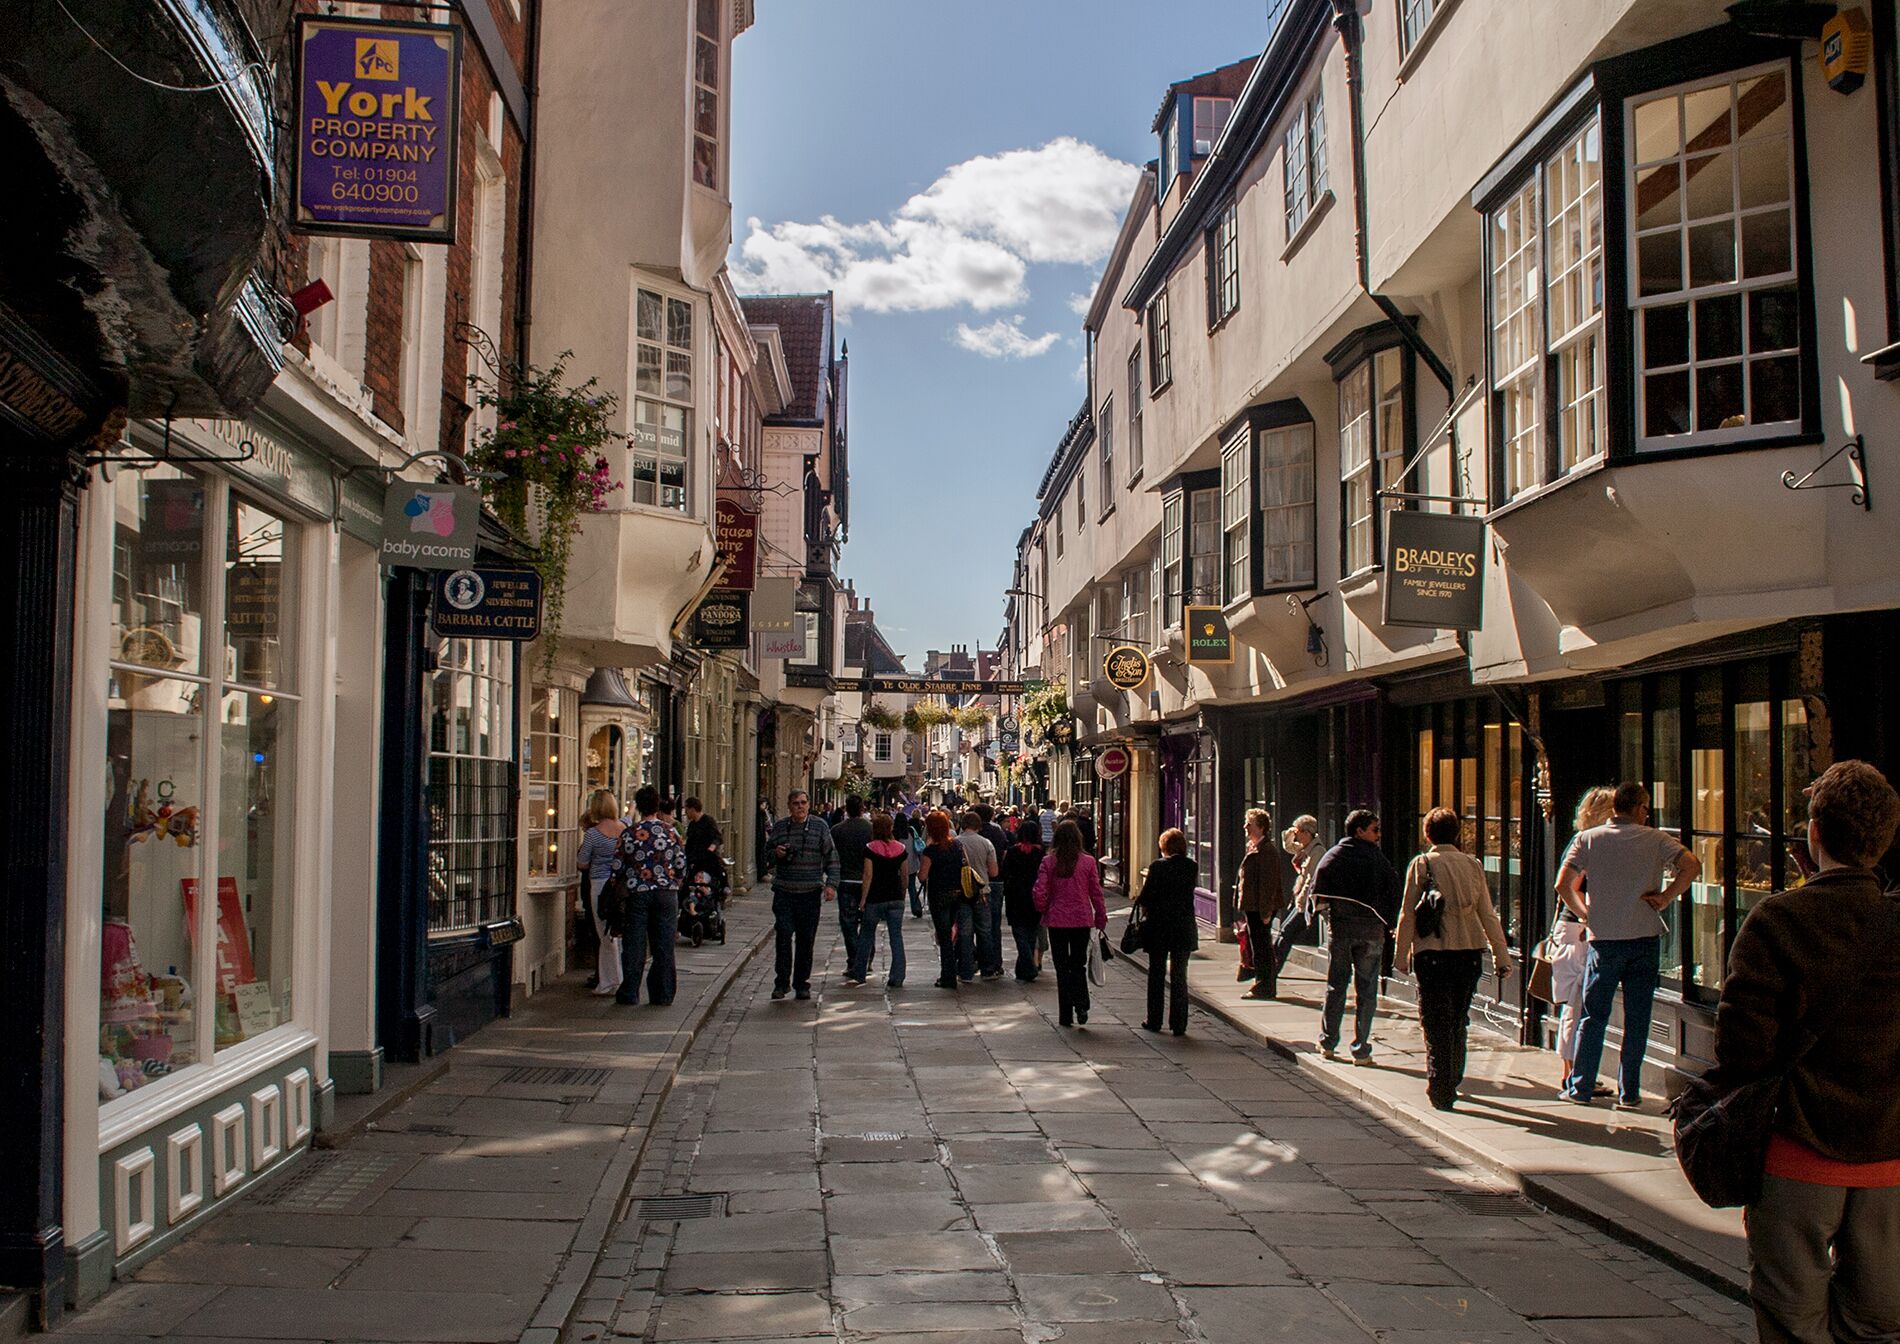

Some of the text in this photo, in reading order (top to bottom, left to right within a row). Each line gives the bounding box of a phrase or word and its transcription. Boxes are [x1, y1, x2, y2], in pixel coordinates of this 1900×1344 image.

[1825, 38, 1841, 58] ADT
[315, 80, 433, 121] York
[311, 118, 437, 142] PROPERTY
[311, 138, 437, 162] COMPANY
[332, 165, 417, 182] Tel: 01904
[331, 182, 418, 203] 640900
[632, 428, 680, 448] Pyramid
[251, 431, 293, 480] acorns
[633, 459, 678, 475] GALLERY
[717, 511, 735, 524] he
[716, 525, 753, 539] iques
[383, 538, 471, 559] baby acorns
[1395, 548, 1476, 577] BRADLEYS
[1436, 568, 1465, 576] YORK
[491, 580, 529, 590] JEWELLER
[1403, 579, 1466, 591] FAMILY JEWELLERS
[1417, 589, 1453, 598] SINCE 1970
[485, 597, 534, 608] SILVERSMITH
[438, 613, 535, 628] BARBARA CATTLE
[700, 609, 742, 619] PANDORA
[751, 621, 790, 629] IGSAW
[1192, 639, 1227, 647] ROLEX
